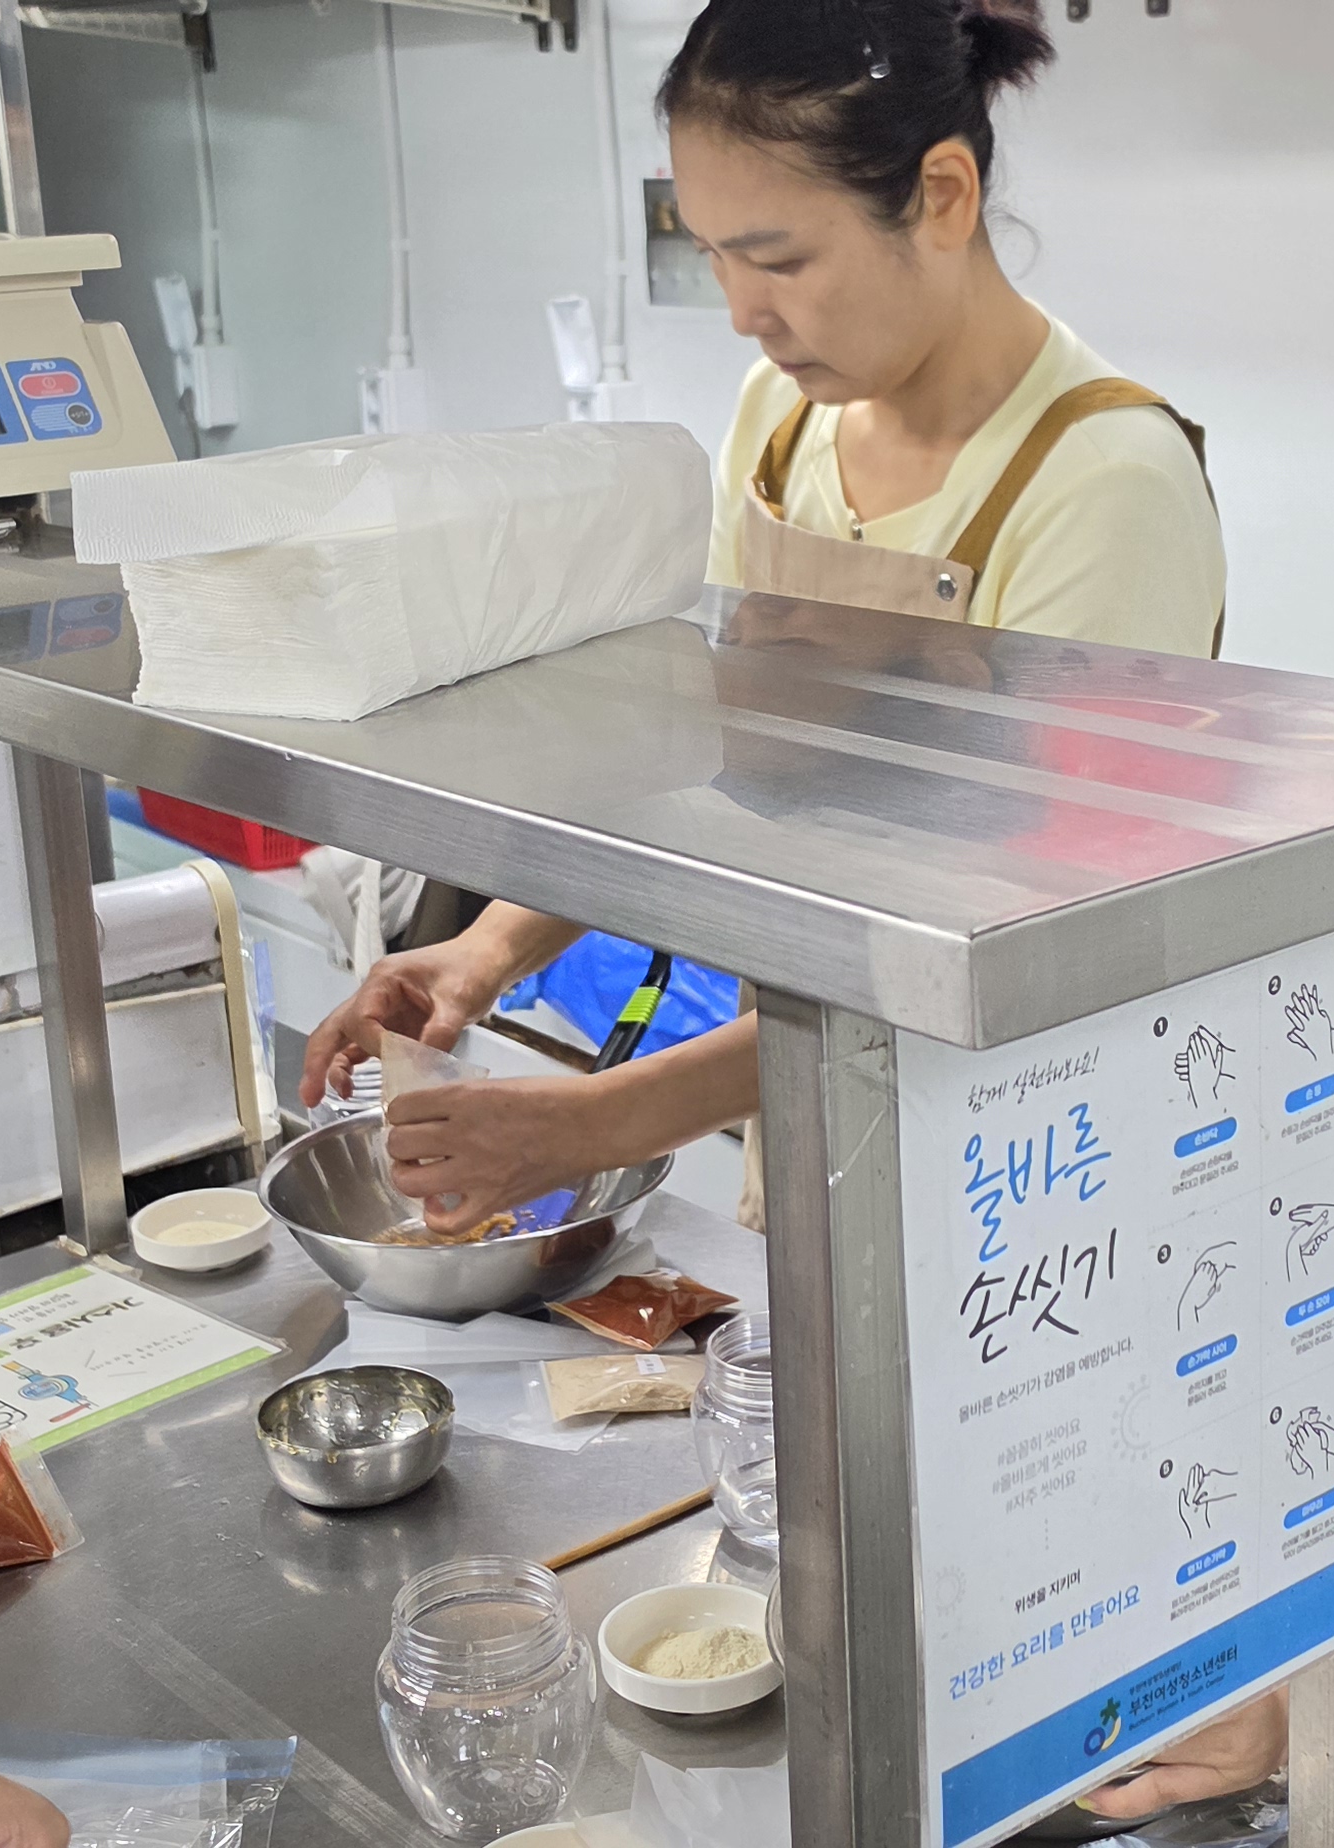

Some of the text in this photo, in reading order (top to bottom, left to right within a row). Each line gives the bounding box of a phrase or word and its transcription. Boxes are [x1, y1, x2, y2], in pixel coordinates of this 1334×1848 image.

[968, 1080, 1008, 1114] 함께
[964, 1103, 1111, 1263] 올바른
[960, 1228, 1117, 1364] 손씻기
[42, 1297, 145, 1338] 가스사용
[958, 1336, 1133, 1422] 올바른 손씻기가 감염을 예방합니다.
[1045, 1417, 1080, 1447] 씻어요
[1052, 1440, 1086, 1469] 씻어요
[1040, 1469, 1075, 1499] 씻어요
[1014, 1586, 1046, 1613] 위생을
[949, 1583, 1139, 1700] 건강한 요리를 만들어요
[1129, 1643, 1238, 1717] 부천여성청소년센터
